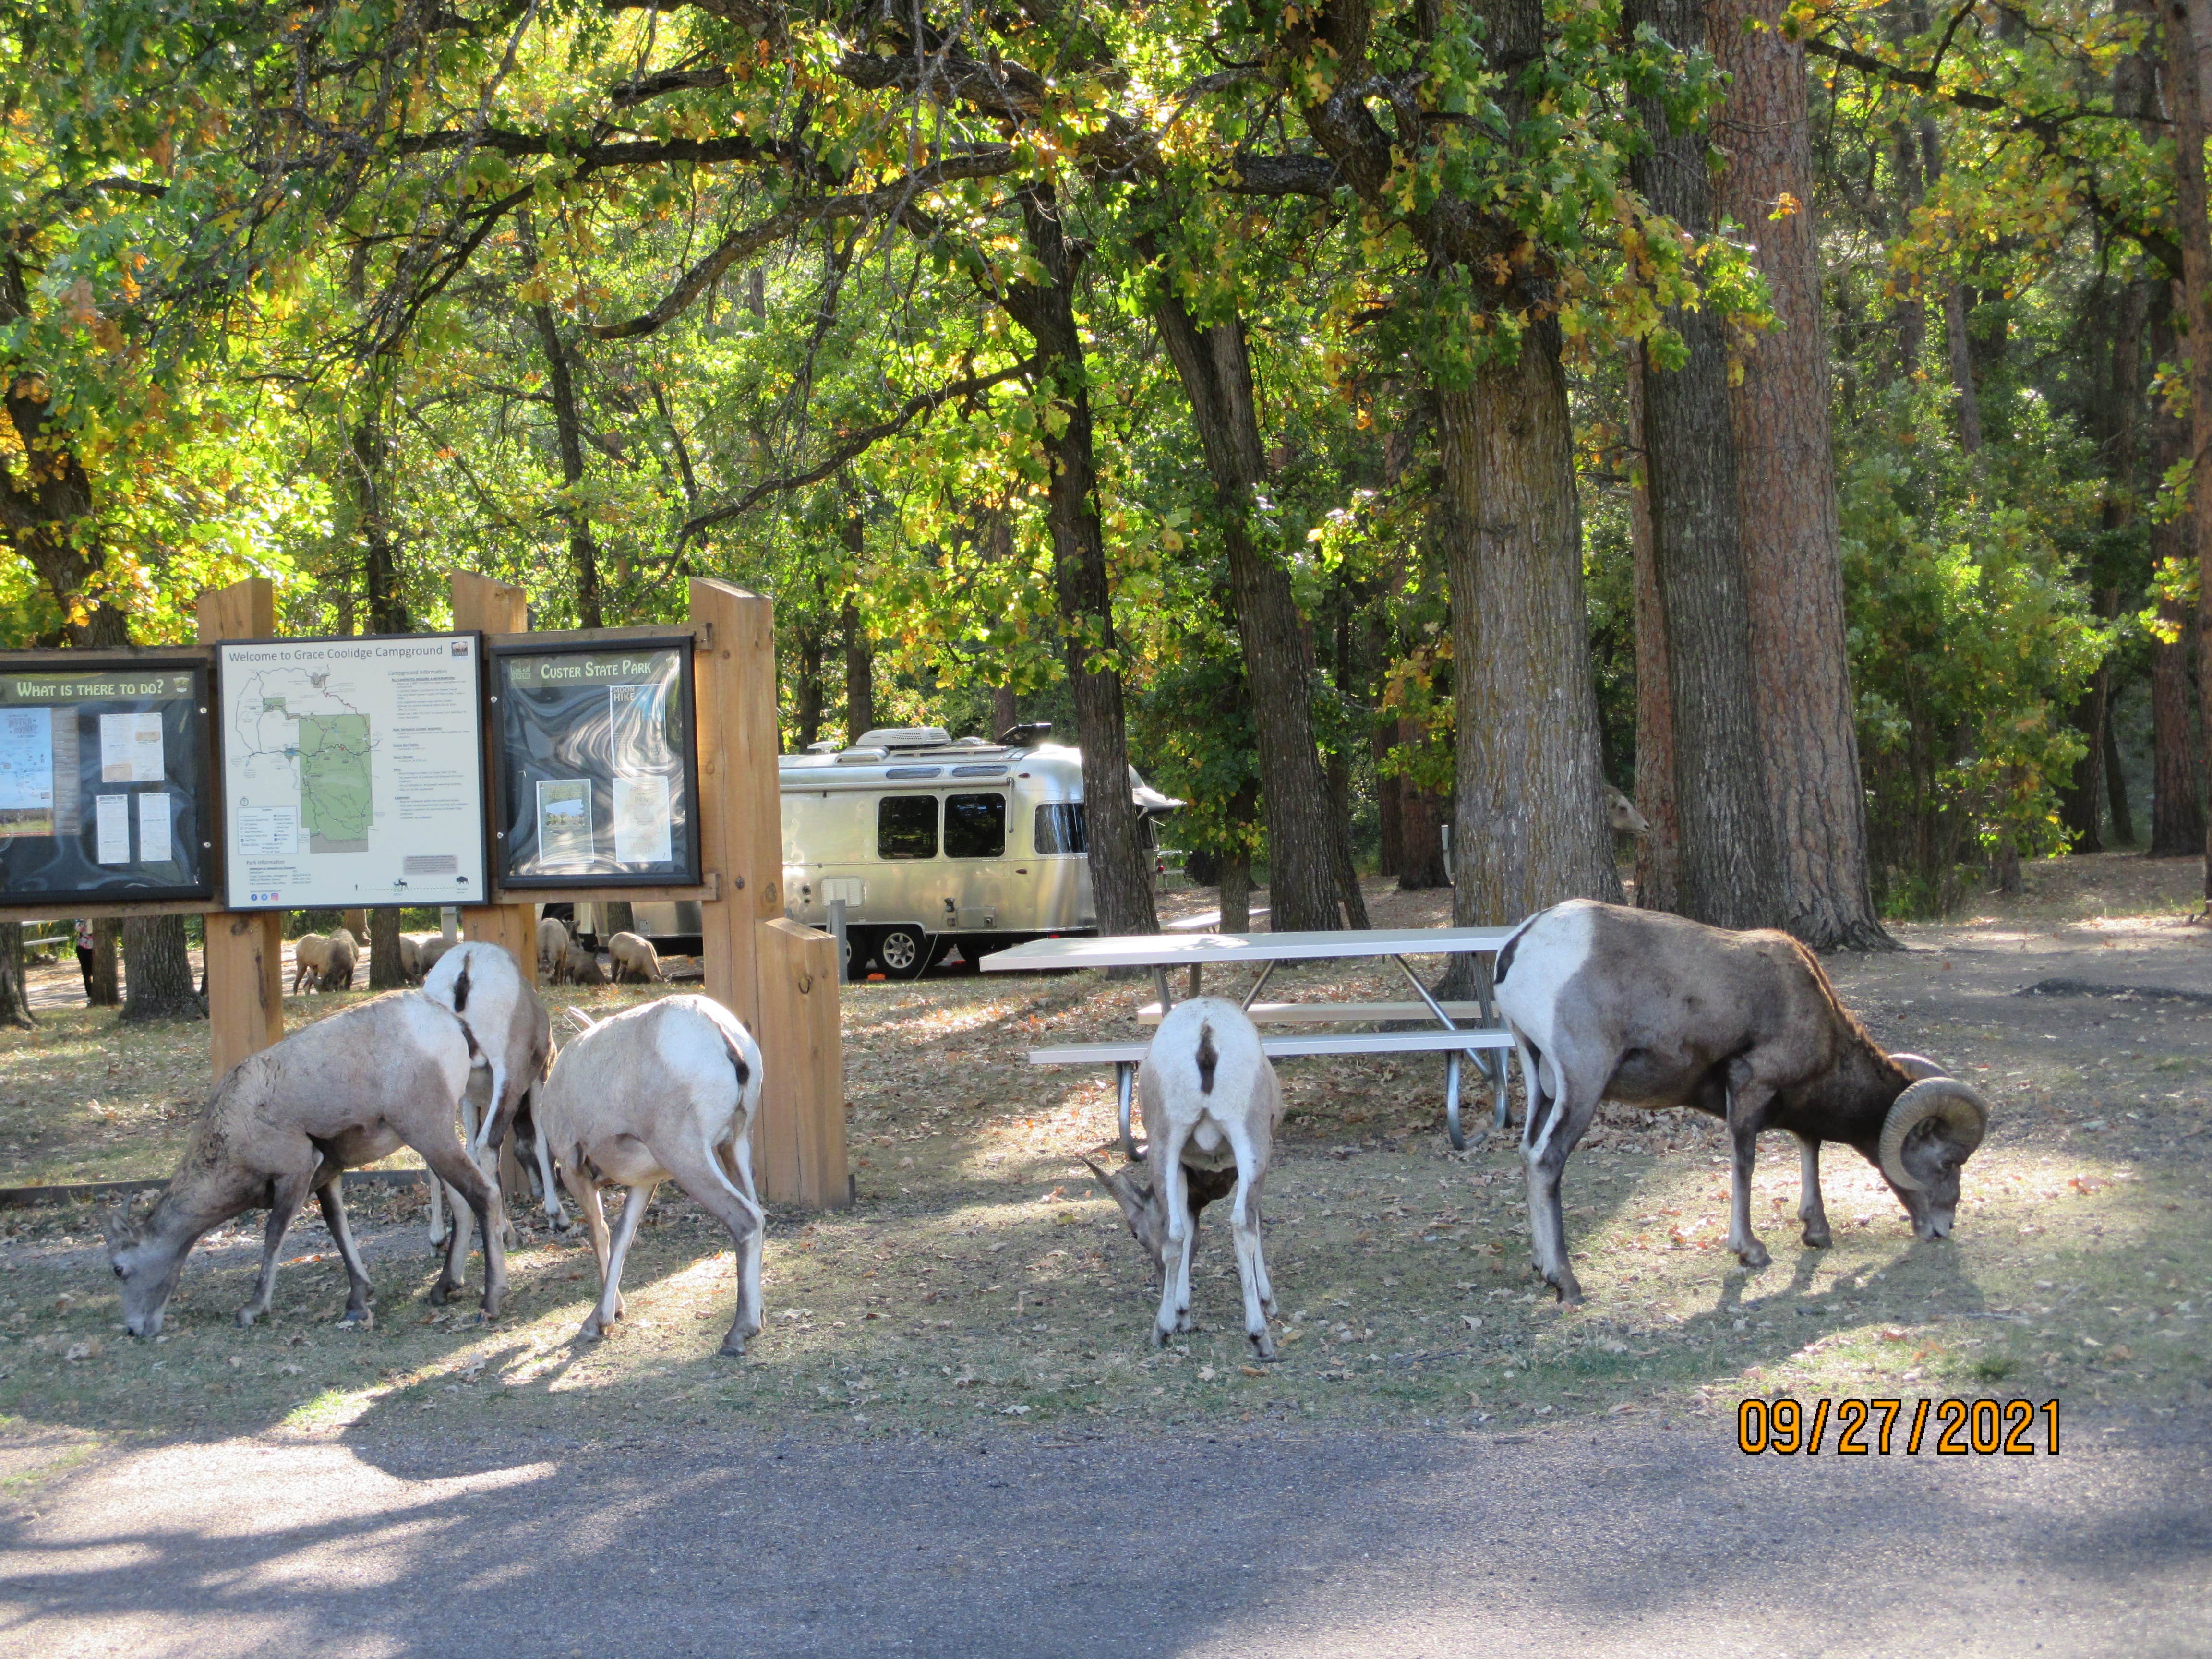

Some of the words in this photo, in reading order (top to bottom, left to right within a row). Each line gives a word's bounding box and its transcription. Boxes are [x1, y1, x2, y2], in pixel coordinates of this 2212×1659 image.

[229, 652, 277, 662] Welcome
[280, 651, 291, 661] to
[294, 650, 325, 660] Grace
[327, 648, 373, 659] Coolidge
[375, 645, 443, 658] Campground
[613, 693, 635, 702] HIKE
